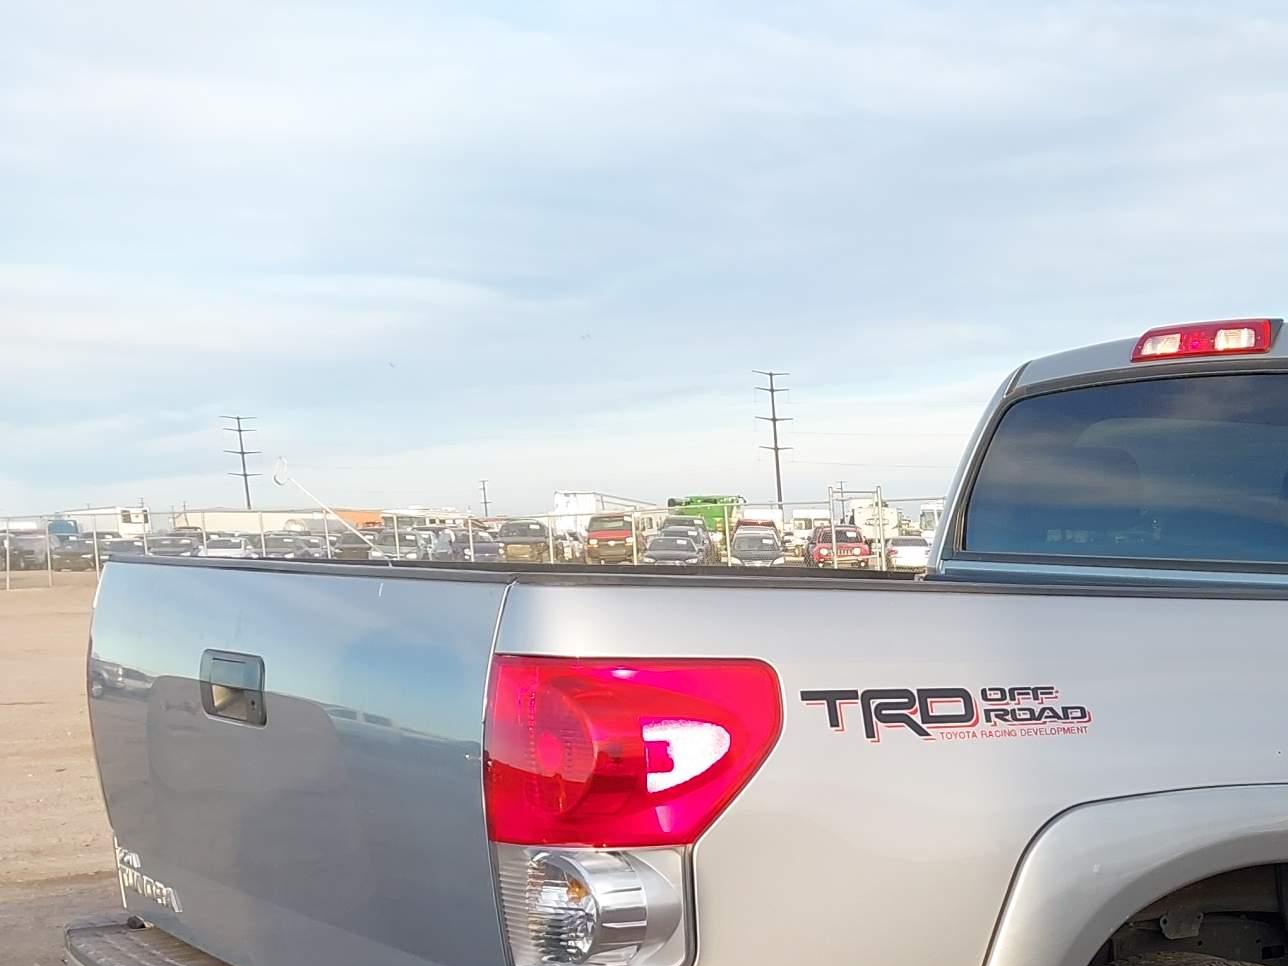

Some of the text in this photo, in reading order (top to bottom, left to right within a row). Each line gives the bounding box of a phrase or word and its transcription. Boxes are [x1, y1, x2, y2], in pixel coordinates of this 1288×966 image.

[981, 686, 1058, 704] OFF
[800, 687, 979, 742] TRD
[984, 706, 1091, 726] ROAD
[940, 726, 1089, 741] TOYOTA RACING DEVELOPMENT
